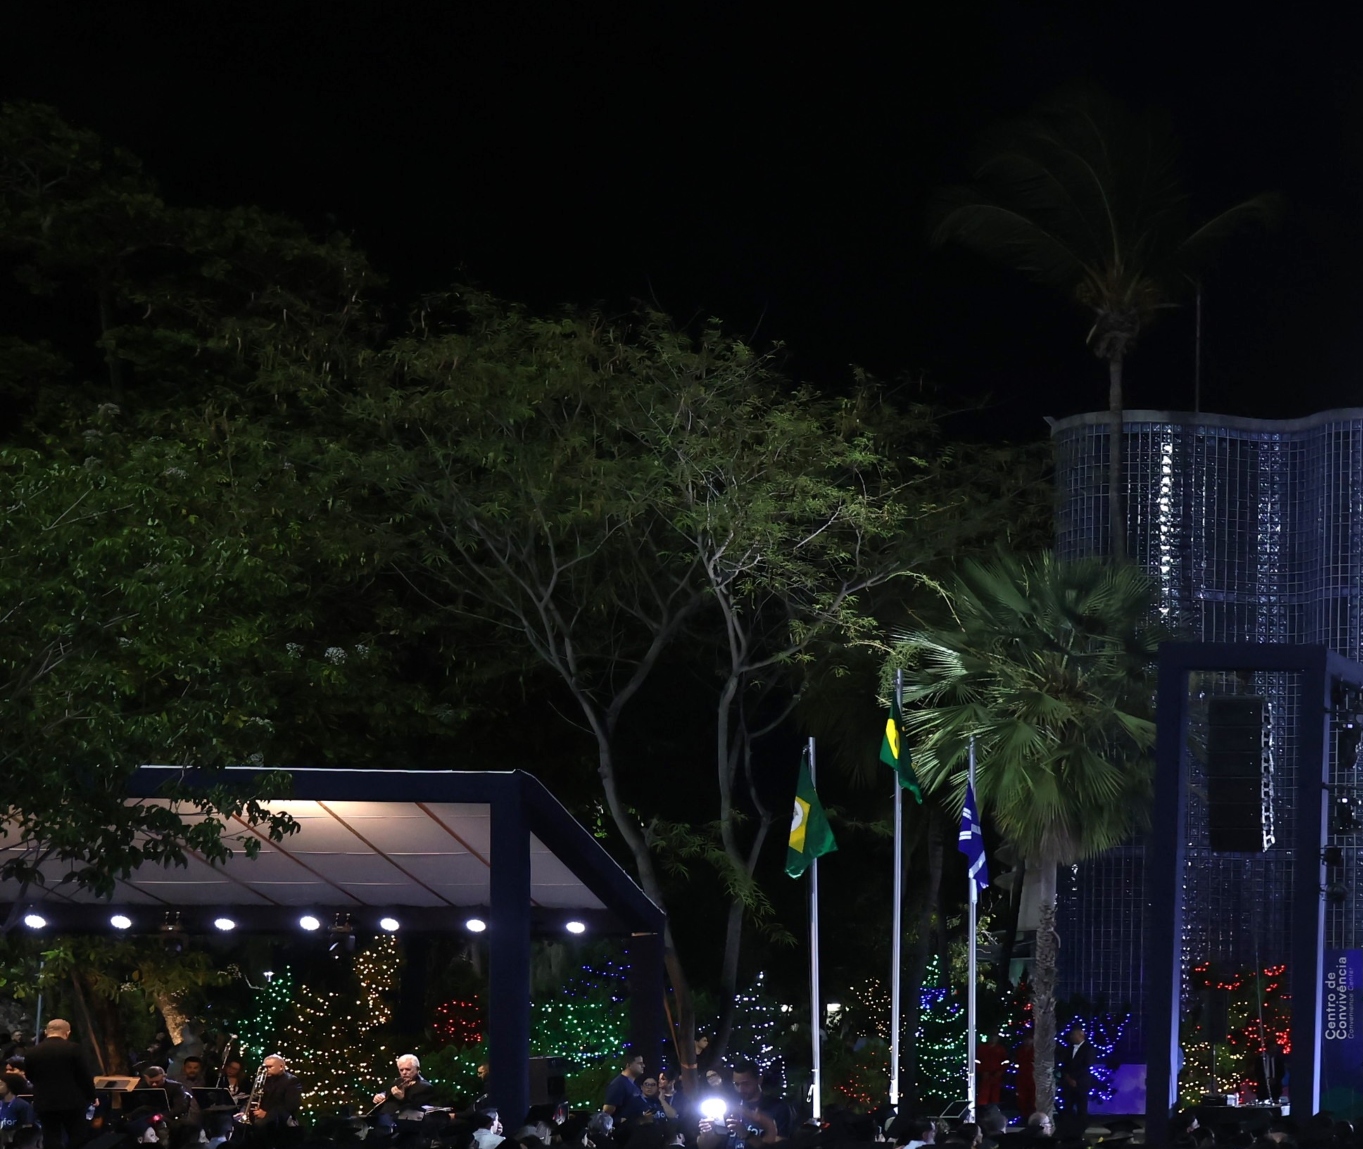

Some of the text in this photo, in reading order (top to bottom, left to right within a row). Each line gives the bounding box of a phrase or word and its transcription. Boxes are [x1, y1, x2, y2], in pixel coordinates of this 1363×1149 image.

[1324, 972, 1336, 1040] Centro de
[1335, 956, 1347, 1040] Convivência
